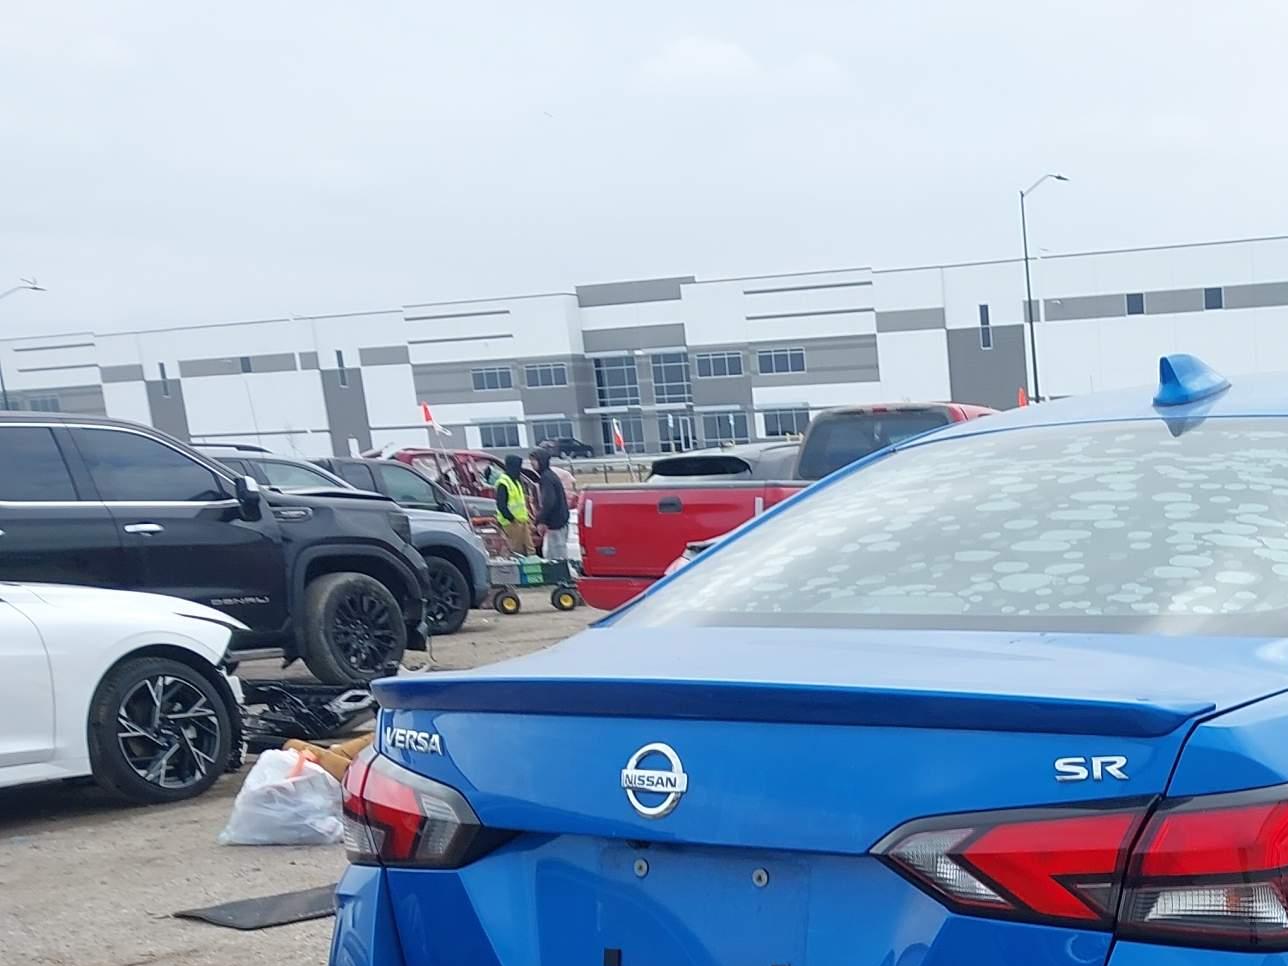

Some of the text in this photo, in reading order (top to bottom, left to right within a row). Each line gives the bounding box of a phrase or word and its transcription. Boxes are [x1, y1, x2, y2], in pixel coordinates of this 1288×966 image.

[386, 726, 442, 756] VERSA
[624, 773, 677, 788] NISSAN
[1054, 755, 1129, 781] SR
